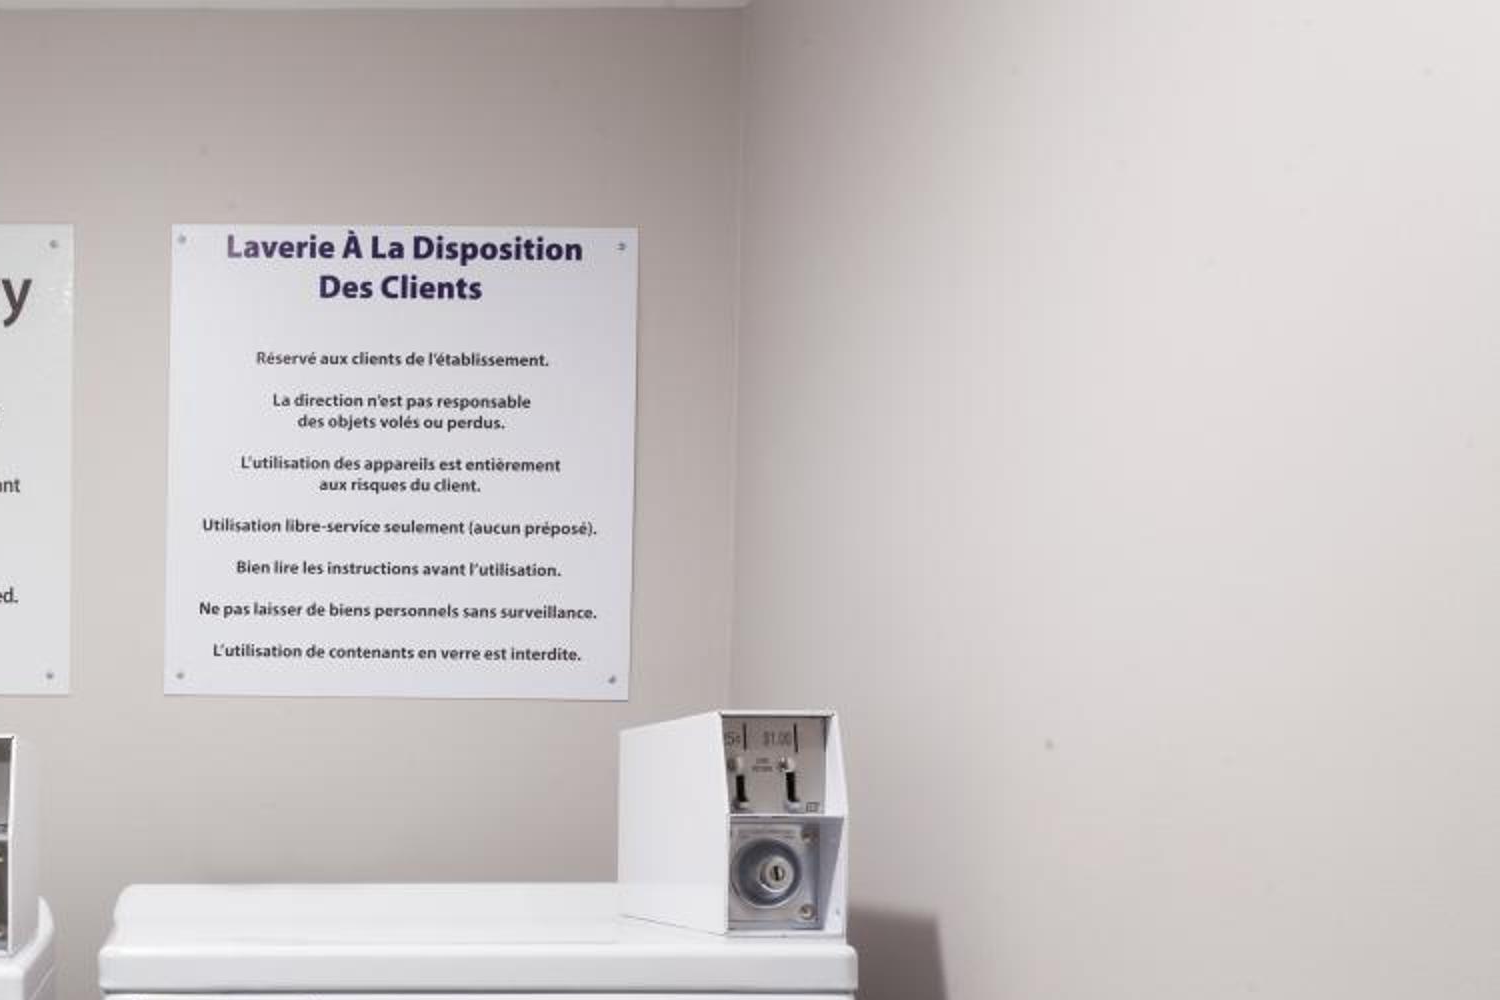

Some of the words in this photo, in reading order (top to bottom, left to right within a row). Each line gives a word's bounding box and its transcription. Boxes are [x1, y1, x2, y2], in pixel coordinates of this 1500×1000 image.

[227, 233, 336, 260] Laverie
[341, 229, 364, 260] À
[371, 235, 405, 260] La
[412, 234, 583, 267] Disposition
[319, 274, 374, 299] Des
[380, 273, 483, 301] Clients
[256, 351, 317, 365] Réservé
[319, 354, 349, 366] aux
[351, 351, 403, 367] clients
[404, 351, 426, 367] de
[272, 393, 291, 407] La
[293, 393, 364, 408] direction
[405, 396, 434, 411] pas
[436, 394, 532, 412] responsable
[297, 413, 325, 429] des
[327, 413, 377, 432] objets
[379, 414, 421, 429] volés
[422, 418, 444, 429] ou
[446, 415, 506, 433] perdus.
[333, 455, 361, 471] des
[363, 456, 436, 474] appareils
[438, 458, 463, 472] est
[464, 457, 561, 473] entièrement
[318, 480, 347, 492] aux
[350, 477, 407, 495] risques
[409, 477, 431, 492] du
[433, 477, 481, 493] client.
[202, 517, 282, 533] Utilisation
[285, 518, 381, 534] libre-service
[383, 519, 465, 535] seulement
[468, 520, 521, 537] (aucun
[523, 521, 598, 539] préposé).
[236, 559, 271, 575] Bien
[273, 559, 300, 575] lire
[302, 560, 325, 575] les
[327, 561, 420, 577] instructions
[422, 563, 467, 577] avant
[199, 601, 221, 616] Ne
[223, 605, 251, 619] pas
[253, 601, 303, 617] laisser
[305, 602, 326, 617] de
[328, 602, 372, 617] biens
[373, 603, 460, 621] personnels
[462, 607, 498, 619] sans
[500, 604, 597, 620] surveillance.
[305, 644, 326, 659] de
[328, 646, 415, 660] contenants
[417, 648, 438, 660] en
[440, 649, 481, 661] verre
[483, 648, 507, 661] est
[510, 646, 582, 662] interdite.
